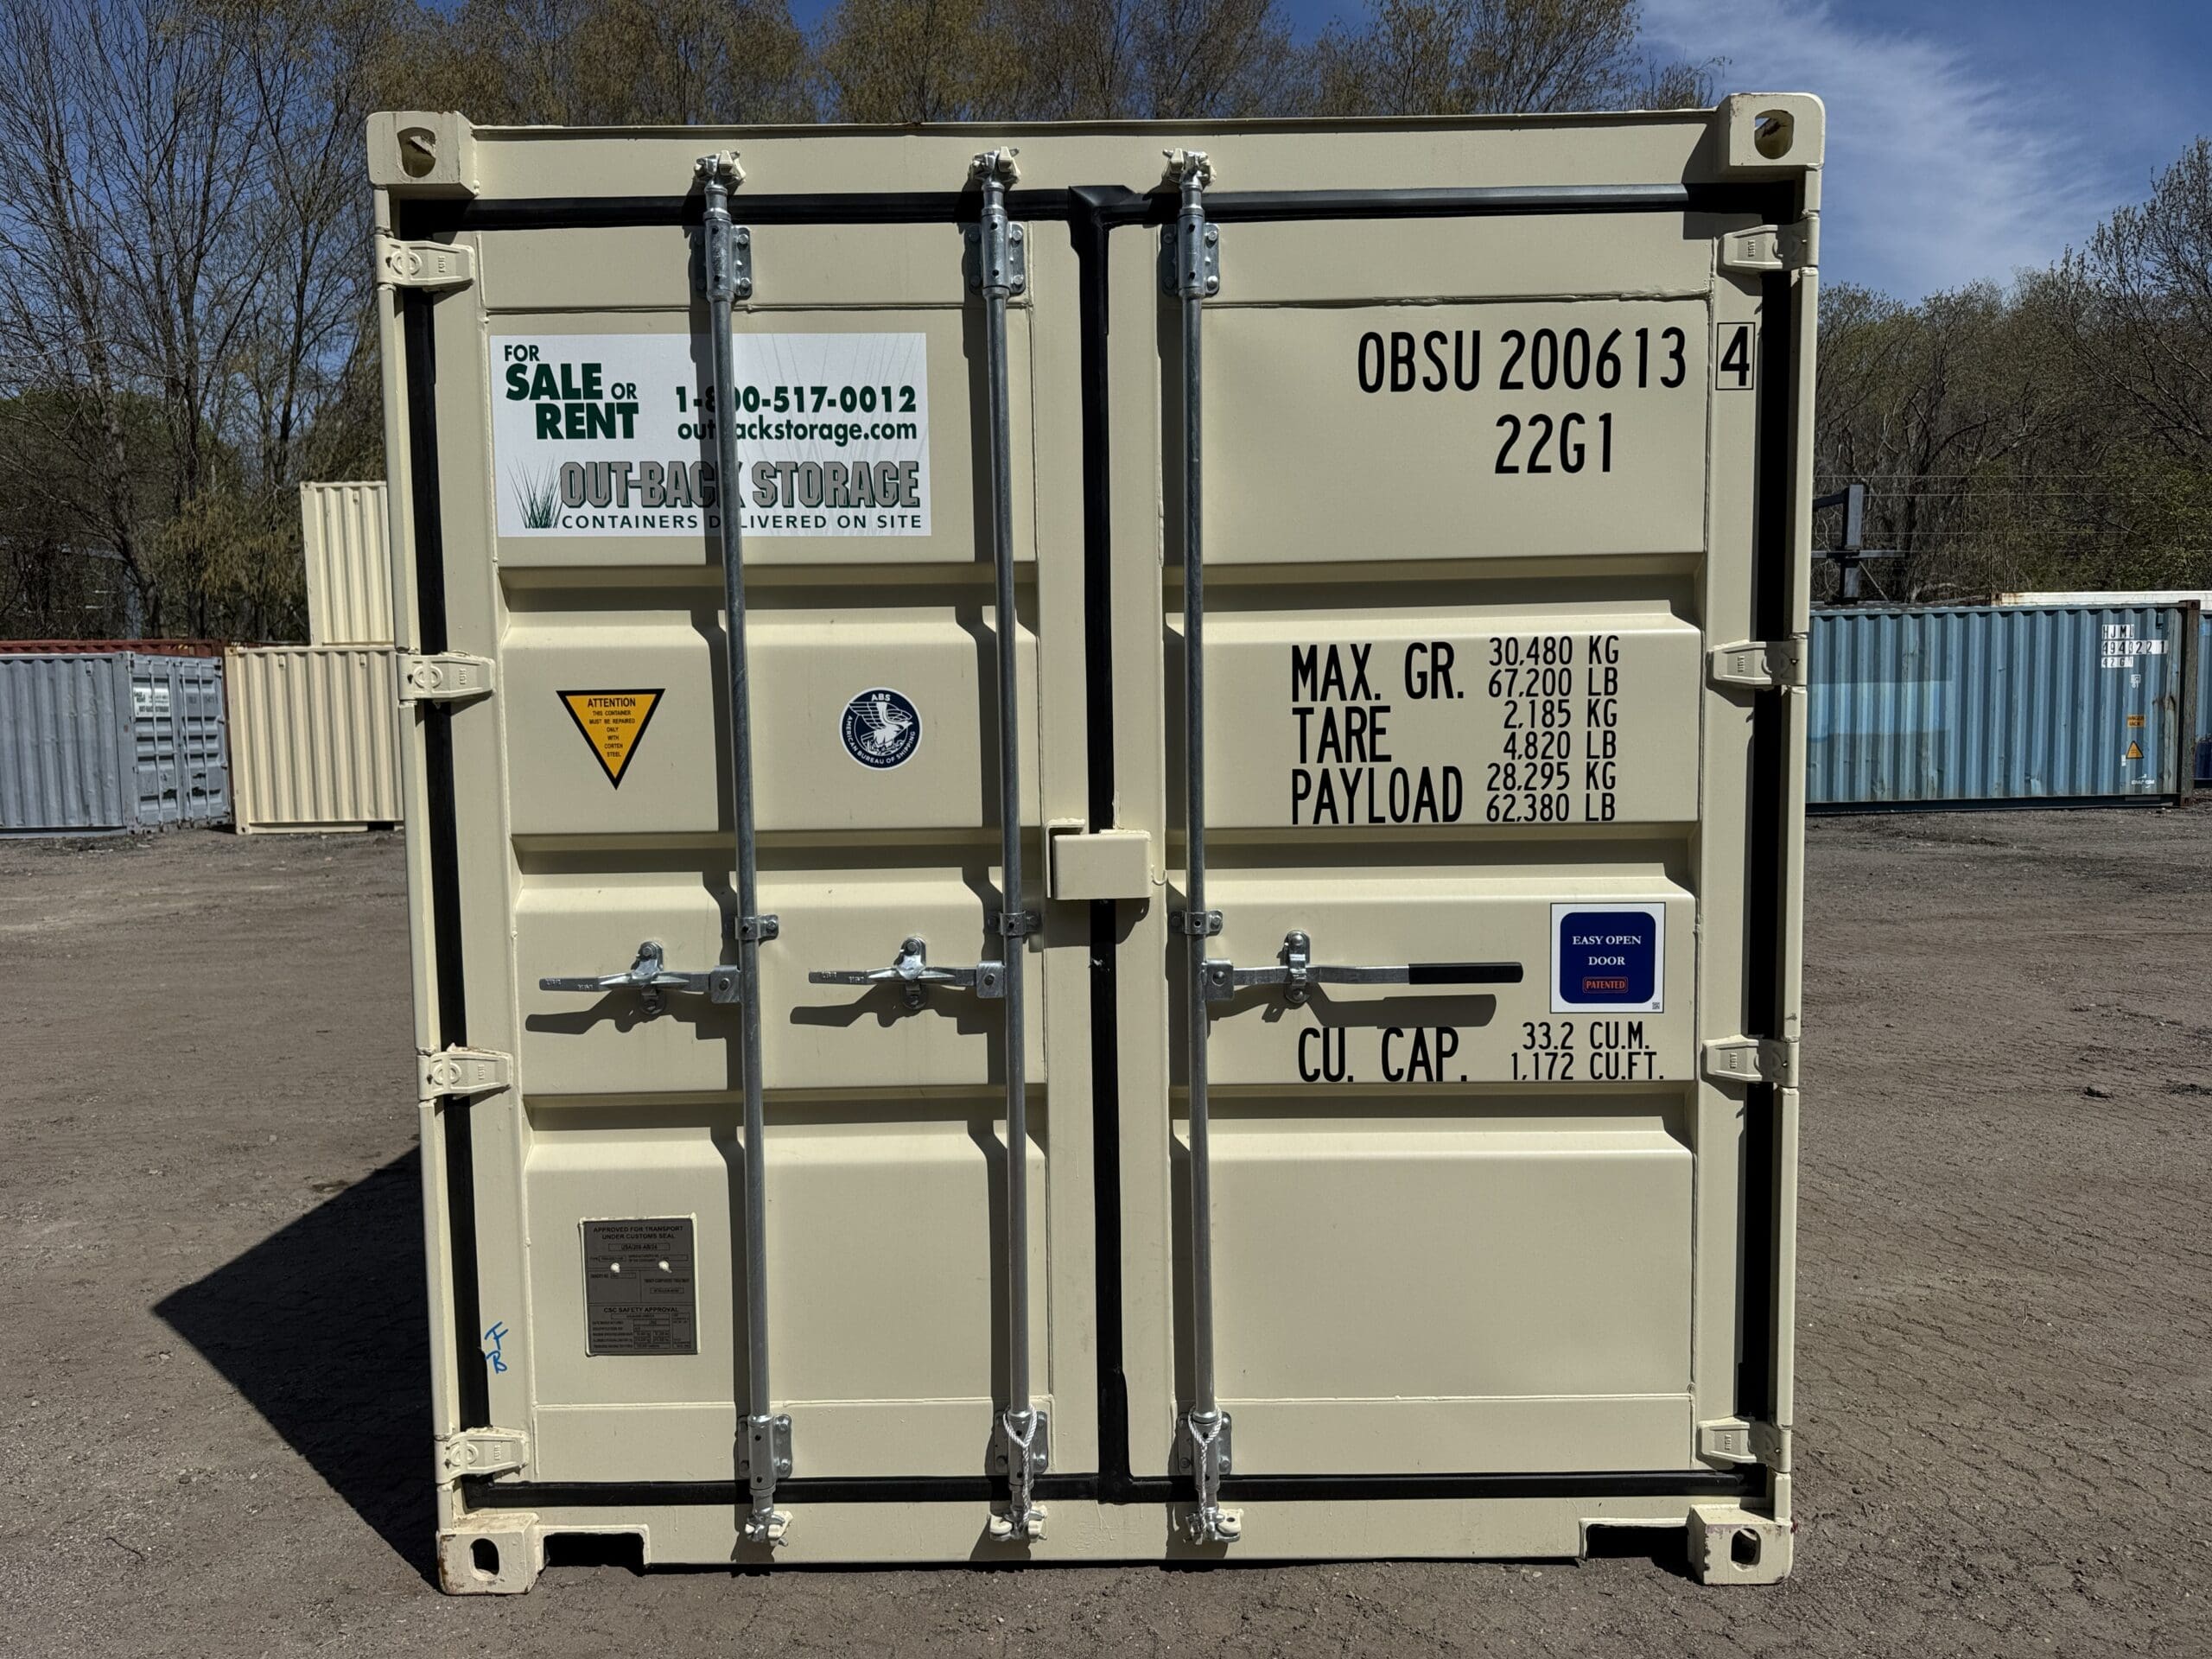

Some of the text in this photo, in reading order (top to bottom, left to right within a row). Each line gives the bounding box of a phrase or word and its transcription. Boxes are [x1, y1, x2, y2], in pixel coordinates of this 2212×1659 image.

[505, 345, 539, 364] FOR
[1358, 326, 1750, 393] OBSU 200613 4
[506, 363, 637, 401] SALE OR
[536, 403, 639, 439] RENT
[1496, 413, 1611, 474] 22G1
[752, 461, 920, 508] STORAGE
[563, 515, 697, 528] CONTAINERS
[837, 516, 866, 528] ON
[878, 515, 920, 528] SITE
[2101, 626, 2134, 639] HJMU
[1292, 635, 1618, 702] MAX. GR. 30,480 KG
[1488, 667, 1618, 698] 67,200 LB
[588, 698, 636, 708] ATTENTION
[871, 693, 891, 702] ABS
[846, 715, 858, 752] AMERICAN
[857, 751, 884, 764] BUREAU
[896, 731, 916, 759] SHIPPING
[1293, 698, 1617, 764] TARE 2,185 KG
[1503, 730, 1616, 761] 4,820 LB
[1292, 761, 1615, 825] PAYLOAD 28,295 KG
[1486, 793, 1616, 823] 62,380 LB
[1573, 936, 1642, 945] EASY OPEN
[1588, 956, 1625, 965] DOOR
[1586, 981, 1624, 989] PATENTED
[1298, 1021, 1649, 1082] CU. CAP. 33.2 CU.M.
[1512, 1052, 1663, 1082] 1,172 CU.FT.
